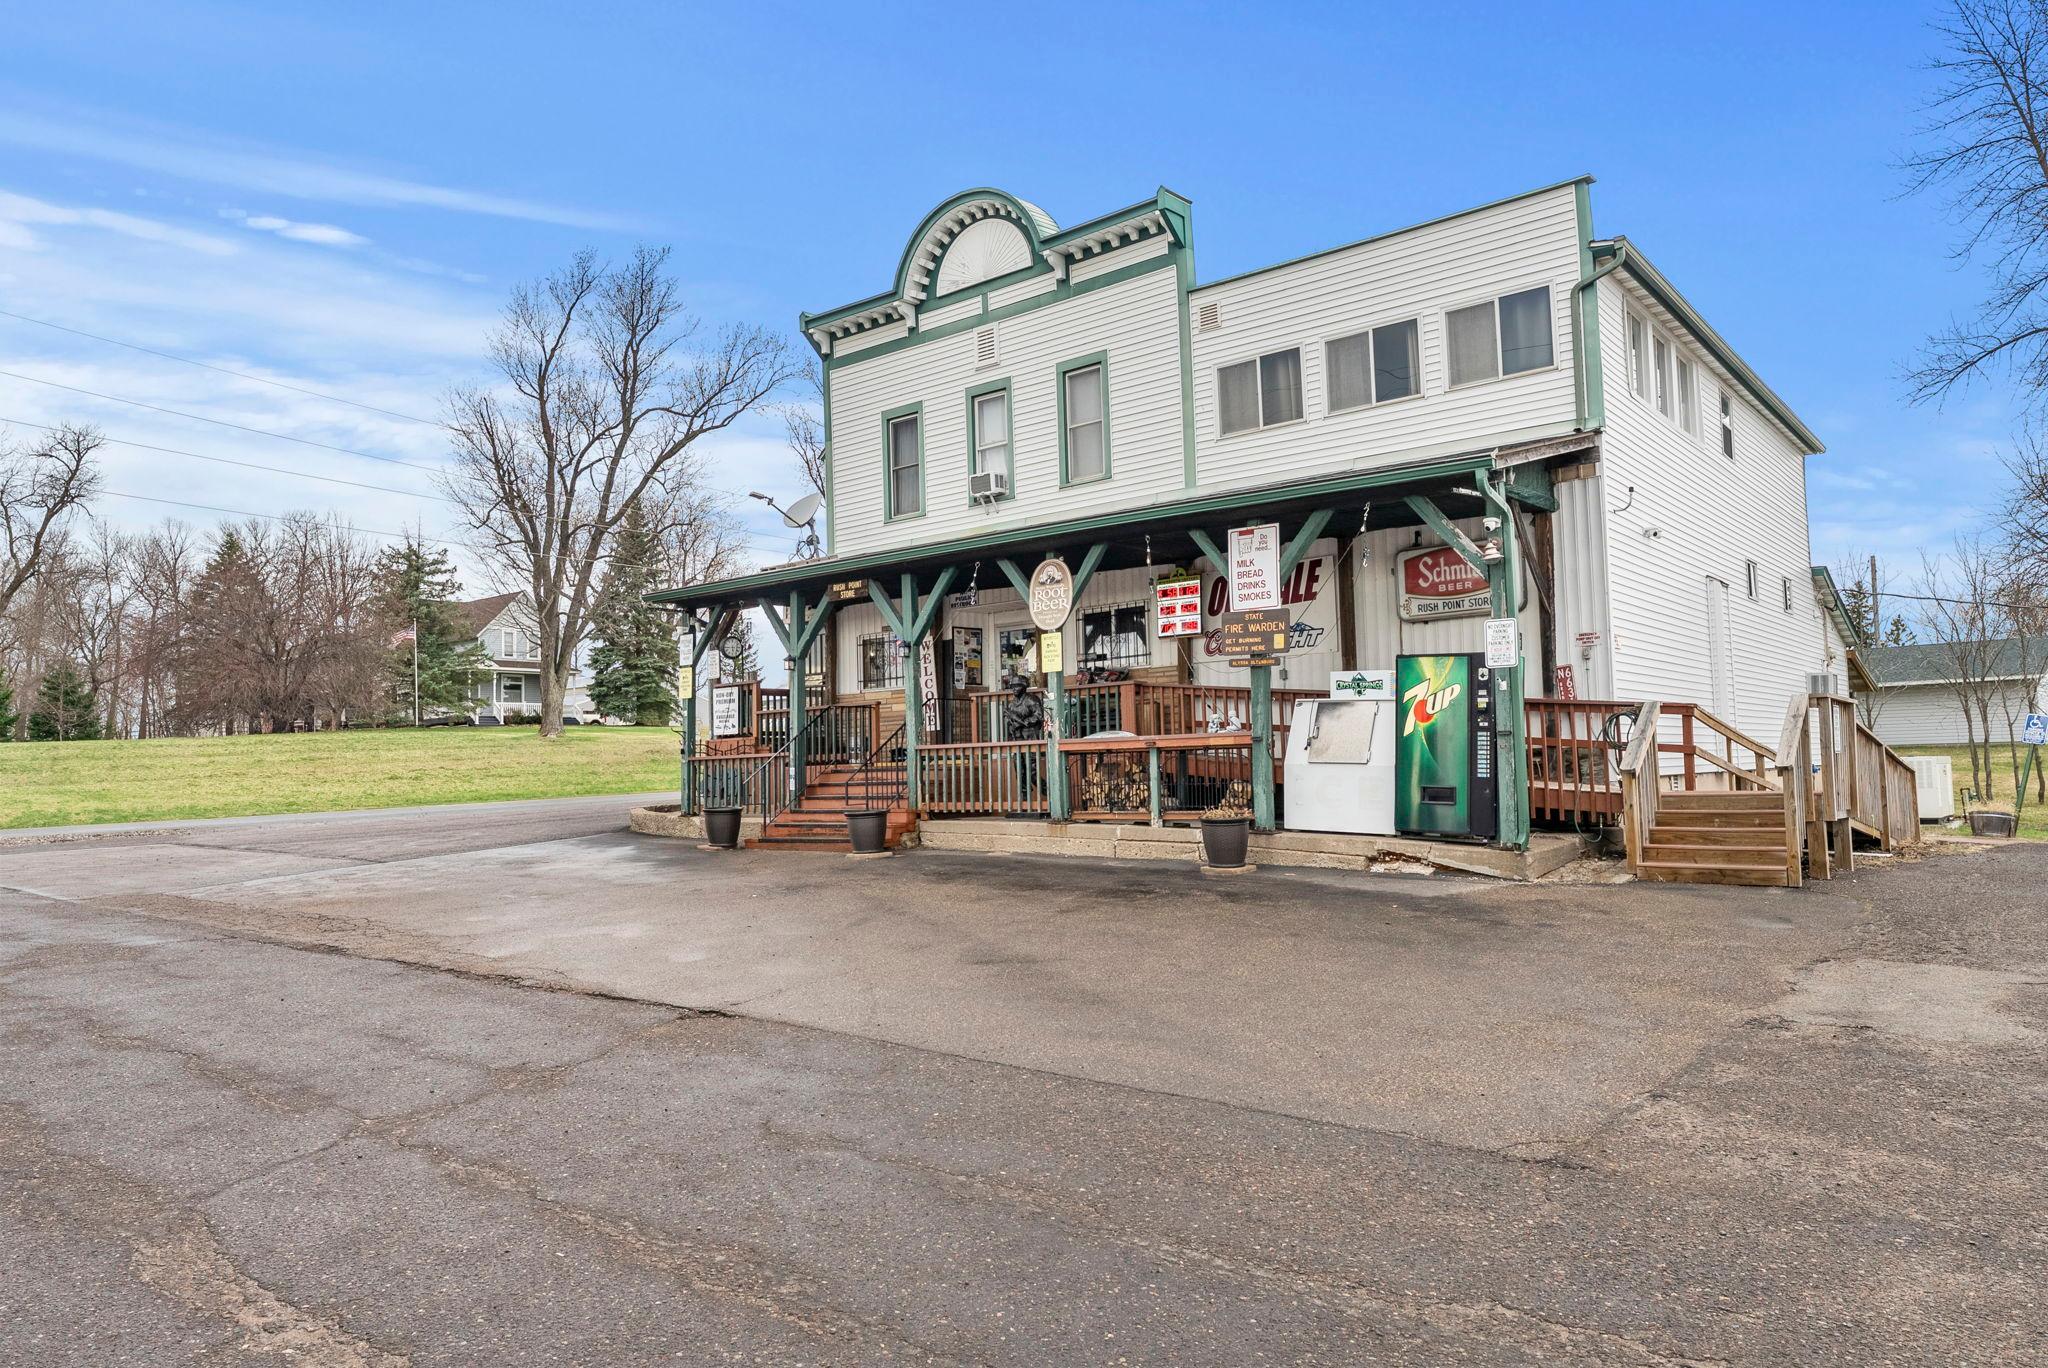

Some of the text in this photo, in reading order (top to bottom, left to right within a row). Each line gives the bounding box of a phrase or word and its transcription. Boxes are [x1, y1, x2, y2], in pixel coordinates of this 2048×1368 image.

[1236, 558, 1255, 568] MILK
[1237, 568, 1264, 579] BREAD
[1237, 580, 1266, 591] DRINKS
[1438, 581, 1473, 592] BEER
[1238, 591, 1272, 602] SMOKES
[1417, 595, 1492, 613] RUSH POINT STOR
[1245, 612, 1264, 620] STATE
[1225, 621, 1285, 634] FIRE WARDEN
[921, 640, 936, 726] WELCOME
[1337, 681, 1383, 690] CRYSTAL SPRINGS
